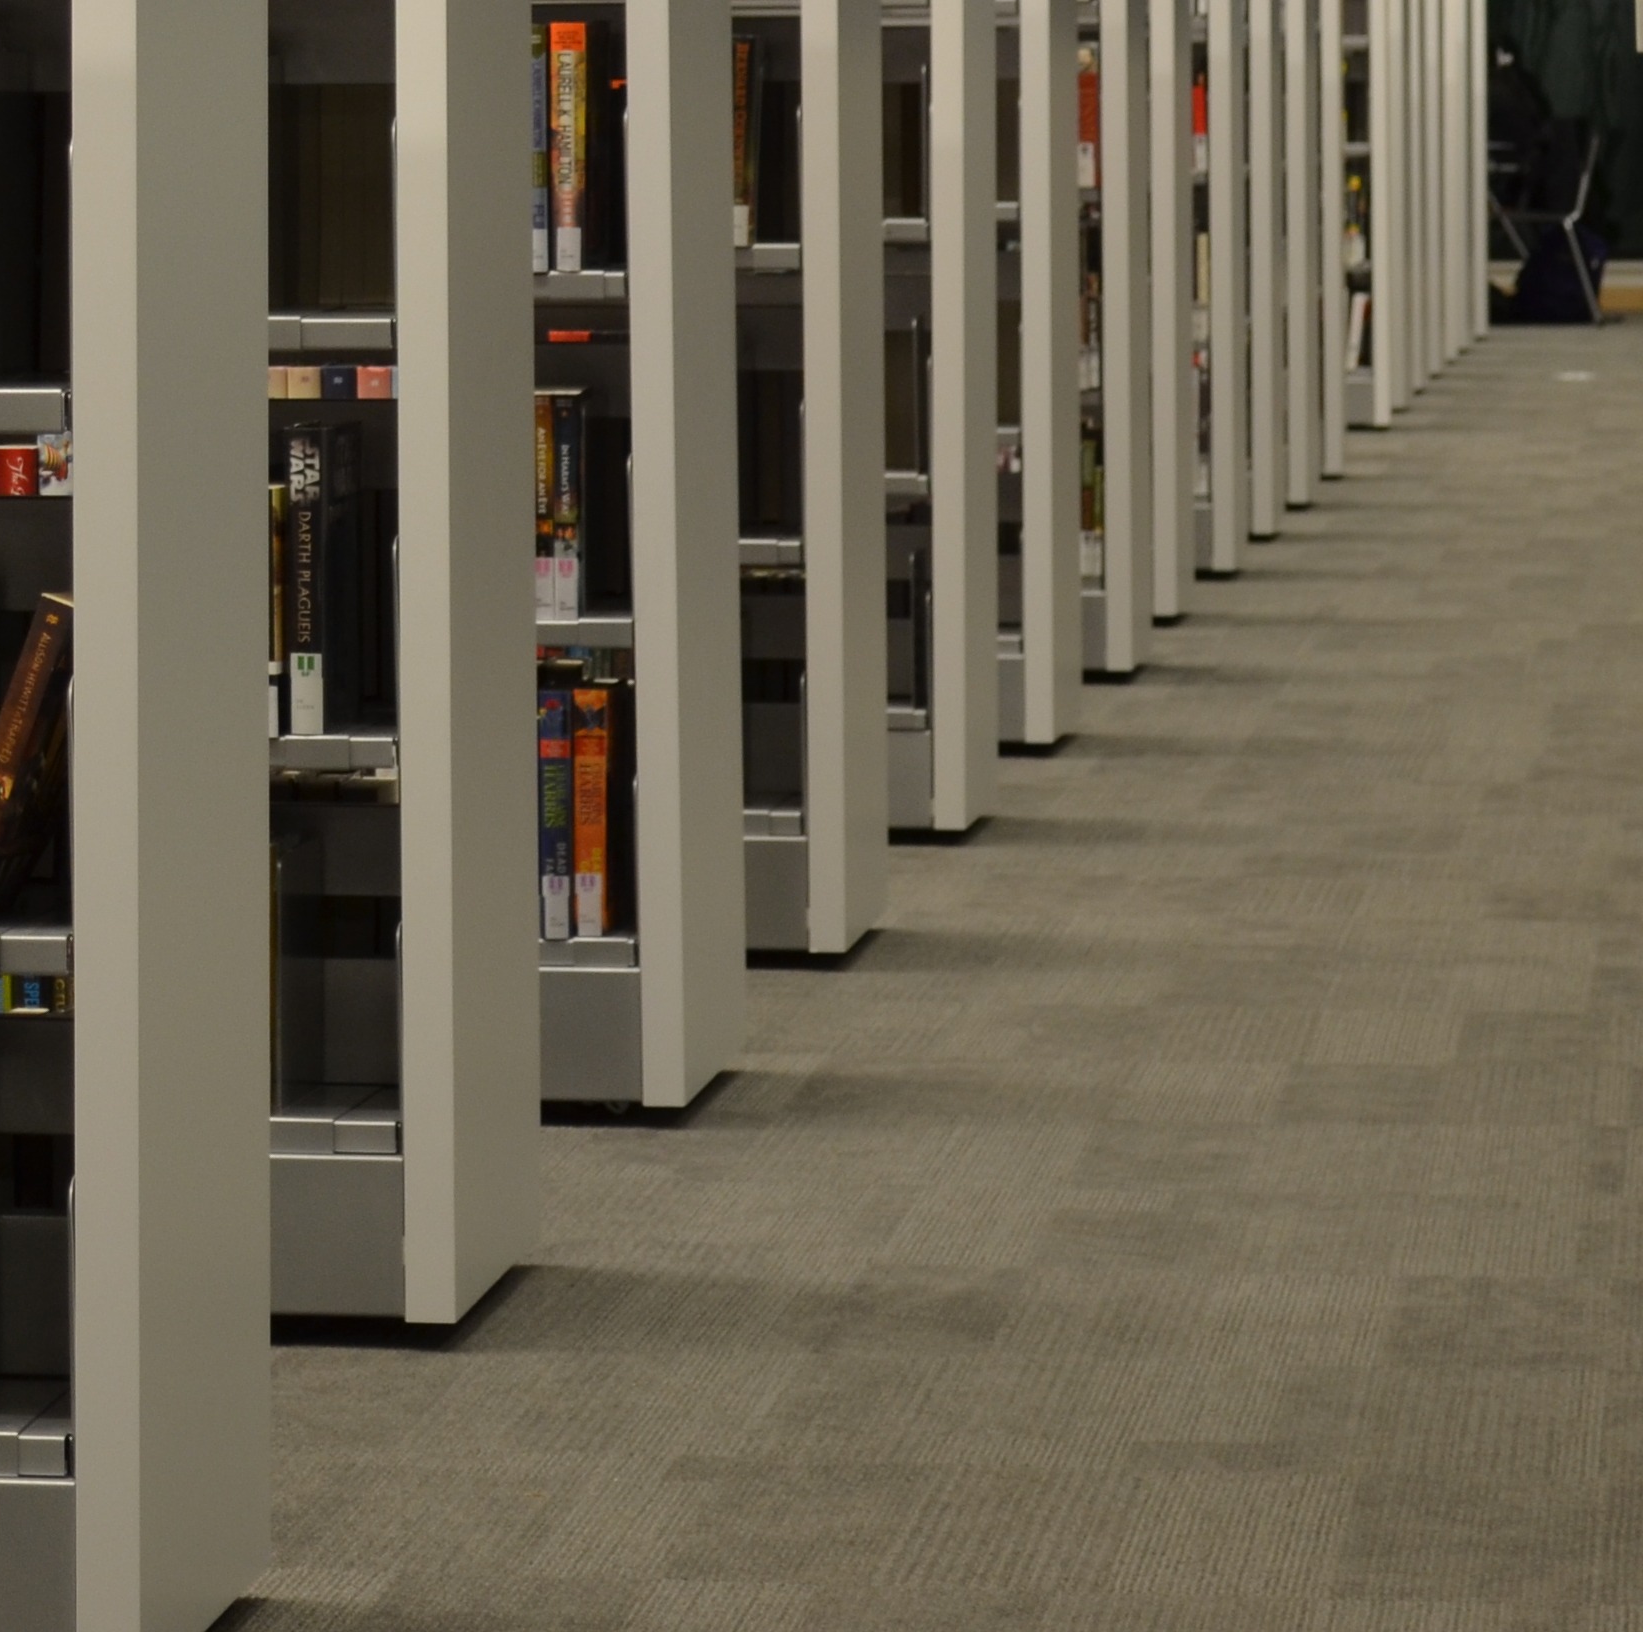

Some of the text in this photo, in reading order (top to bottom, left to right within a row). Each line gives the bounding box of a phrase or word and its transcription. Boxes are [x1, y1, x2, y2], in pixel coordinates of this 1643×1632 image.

[290, 438, 306, 504] WARS
[303, 438, 320, 501] STAR
[298, 511, 312, 564] DARTH
